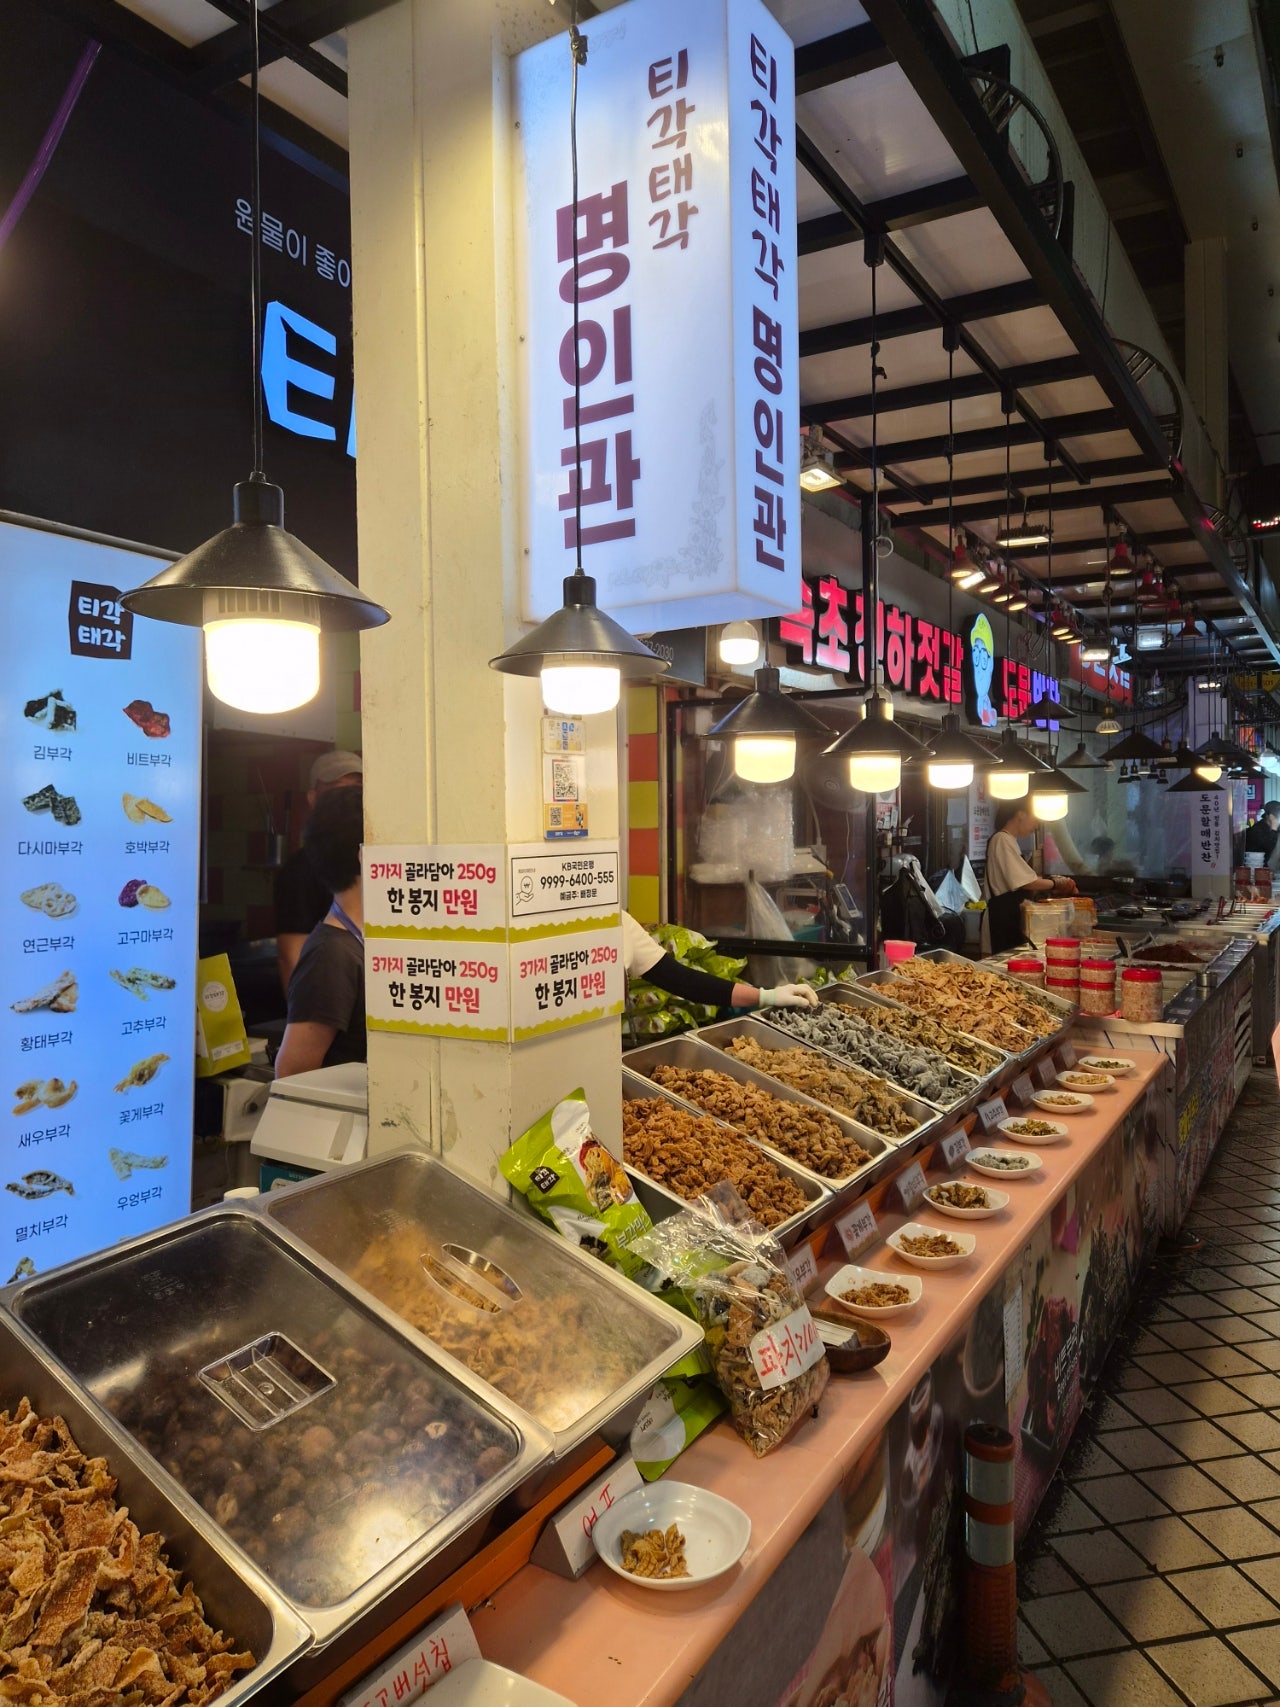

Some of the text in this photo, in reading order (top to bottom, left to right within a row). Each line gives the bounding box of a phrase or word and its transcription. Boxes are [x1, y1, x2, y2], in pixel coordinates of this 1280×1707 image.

[646, 48, 699, 250] 티각태각
[750, 32, 787, 573] 티각태각 명인관
[556, 180, 641, 549] 명인관
[78, 595, 126, 625] 티각
[78, 624, 127, 653] 태각
[33, 745, 73, 762] 김부각
[127, 752, 172, 767] 비트부각
[18, 840, 83, 856] 다시마부각
[124, 840, 170, 855] 호박부각
[370, 862, 496, 884] 3가지 골라담아 250g
[561, 860, 595, 872] KB국민은행
[540, 871, 615, 889] 9999-6400-555
[387, 887, 478, 916] 한 봉지 만원
[22, 936, 75, 954] 연근부각
[117, 927, 173, 946] 고구마부각
[372, 956, 498, 983] 3가지 골라담아 250g
[519, 946, 618, 979] 3가지 골라담아 250g
[388, 981, 480, 1014] 한 봉지 만원
[534, 970, 606, 1010] 한 봉지 만원
[121, 1016, 167, 1036] 고추부각
[20, 1030, 73, 1052] 황태부각
[119, 1102, 165, 1125] 꽃게부각
[18, 1124, 71, 1149] 새우부각
[540, 1174, 556, 1190] 태각
[117, 1186, 163, 1210] 우엉부각
[15, 1214, 69, 1242] 멸치부각
[793, 1258, 812, 1282] 우부각
[363, 1637, 452, 1707] 고버섯칩
